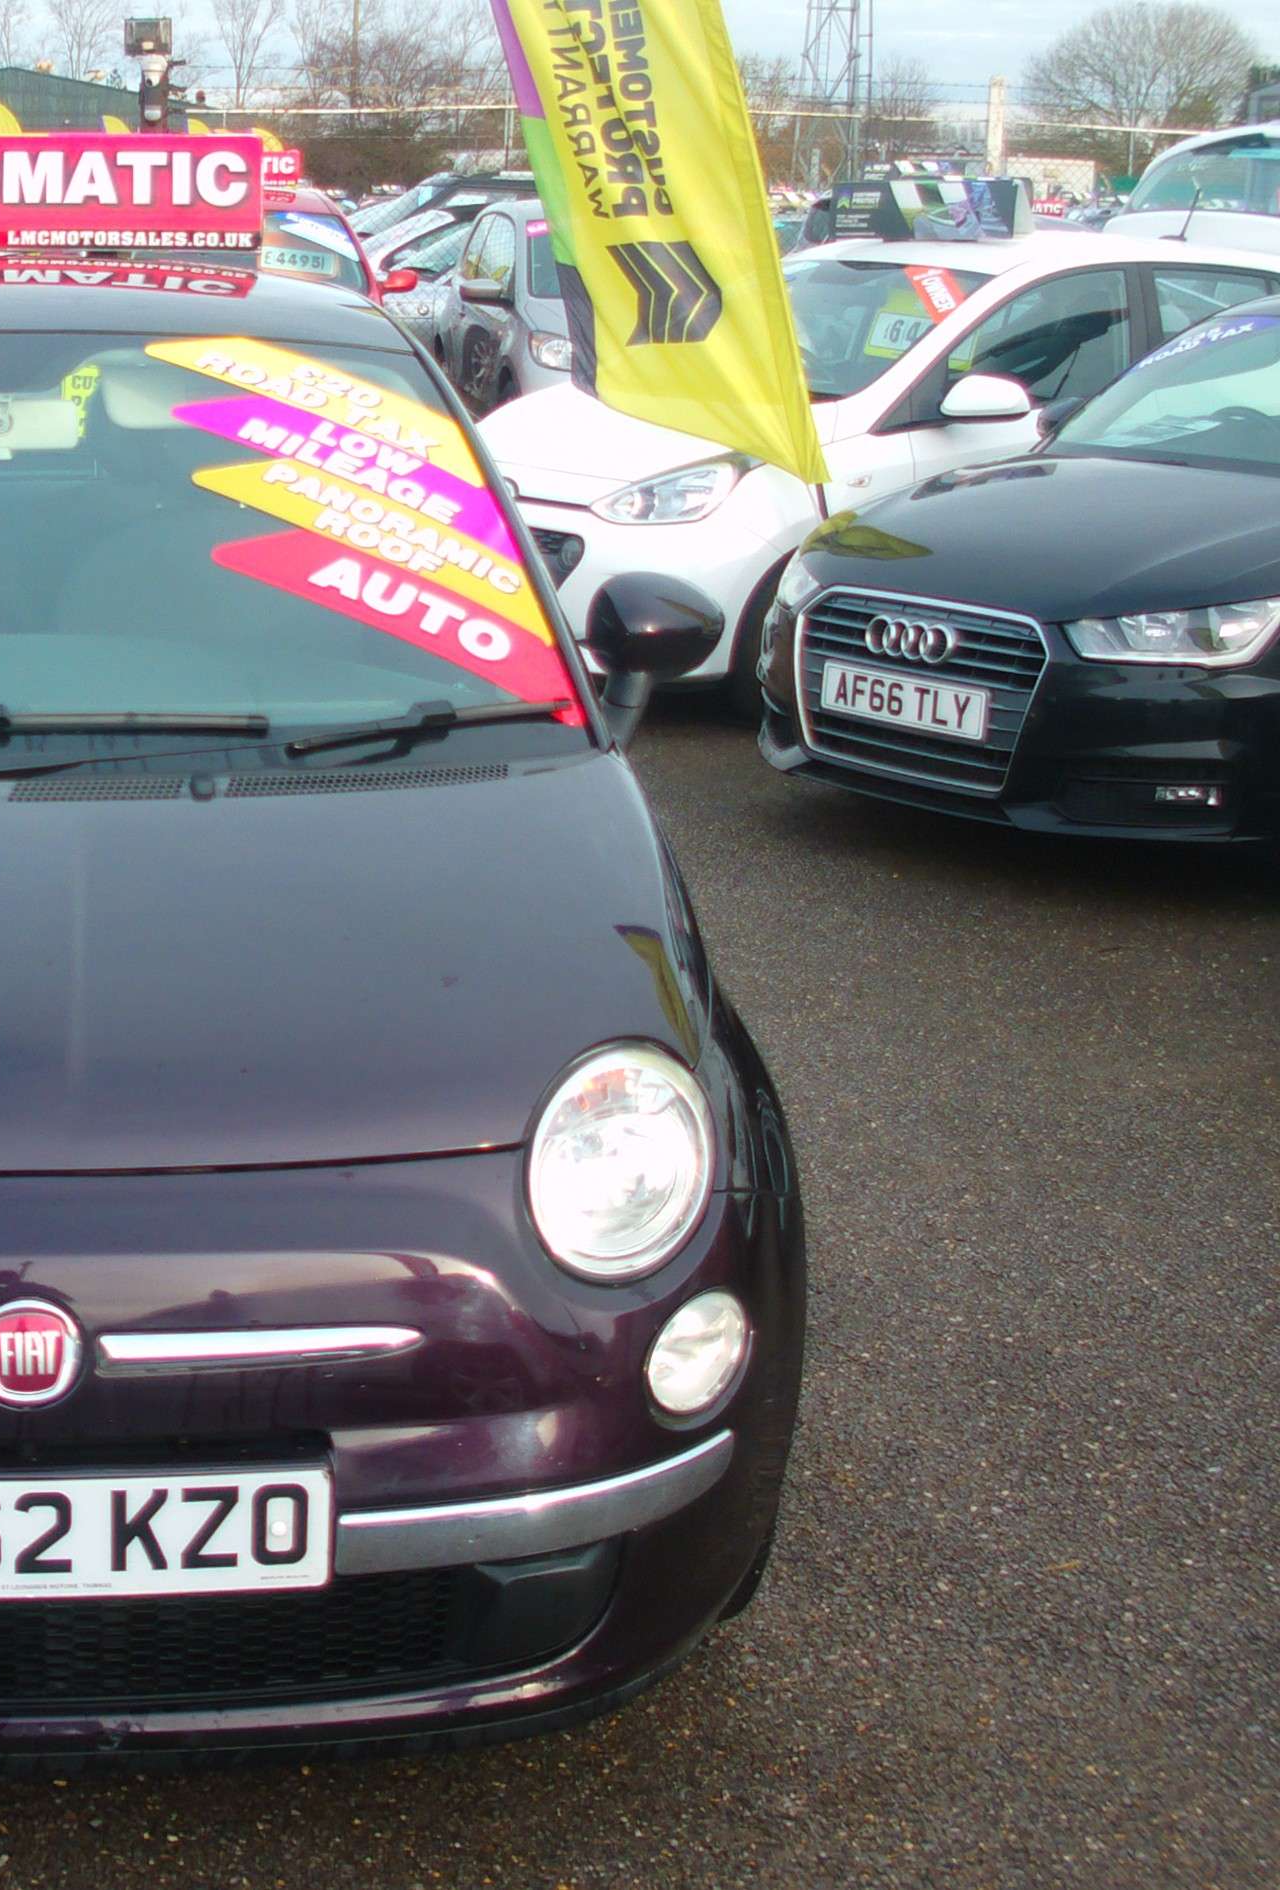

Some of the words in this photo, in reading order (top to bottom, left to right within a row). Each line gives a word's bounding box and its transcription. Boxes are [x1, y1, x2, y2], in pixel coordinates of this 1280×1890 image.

[7, 230, 254, 249] LMCMOTORSALES.CO.UK
[194, 352, 330, 410] ROAD
[347, 407, 442, 459] TAX
[237, 417, 463, 527] MILEAGE
[308, 421, 425, 476] LOW
[262, 463, 522, 595] PANORAMIC
[313, 509, 448, 575] ROOF
[307, 558, 512, 662] AUTO
[832, 671, 905, 719] AF66
[913, 687, 973, 731] TLY
[0, 1330, 61, 1377] FIAT
[109, 1483, 310, 1573] KZO
